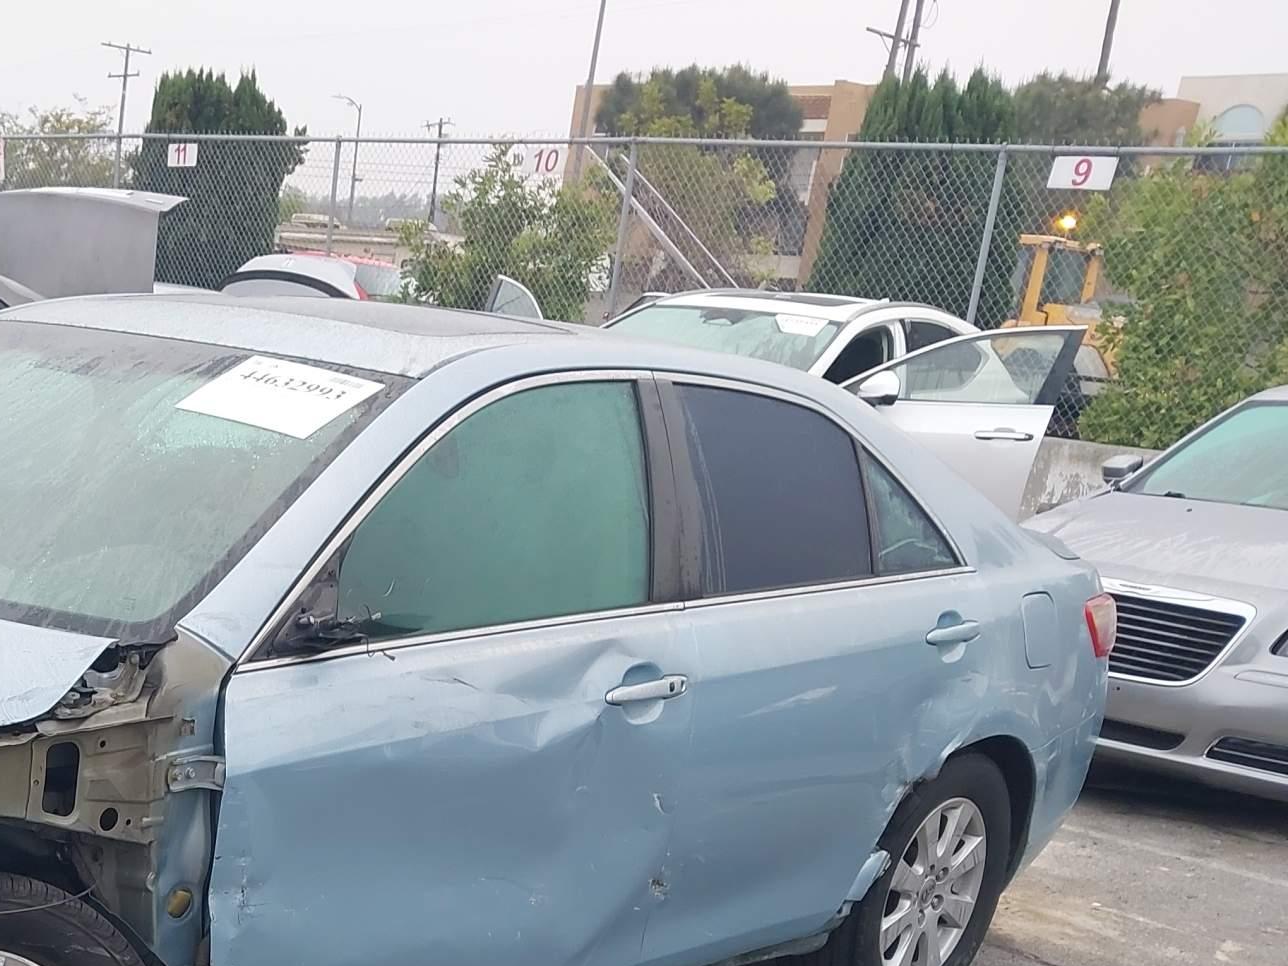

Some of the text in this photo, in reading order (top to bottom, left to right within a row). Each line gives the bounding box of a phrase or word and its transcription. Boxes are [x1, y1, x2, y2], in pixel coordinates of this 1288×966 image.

[175, 144, 187, 165] 11
[534, 149, 559, 173] 10
[1072, 158, 1093, 186] 9
[240, 370, 348, 400] 44632993
